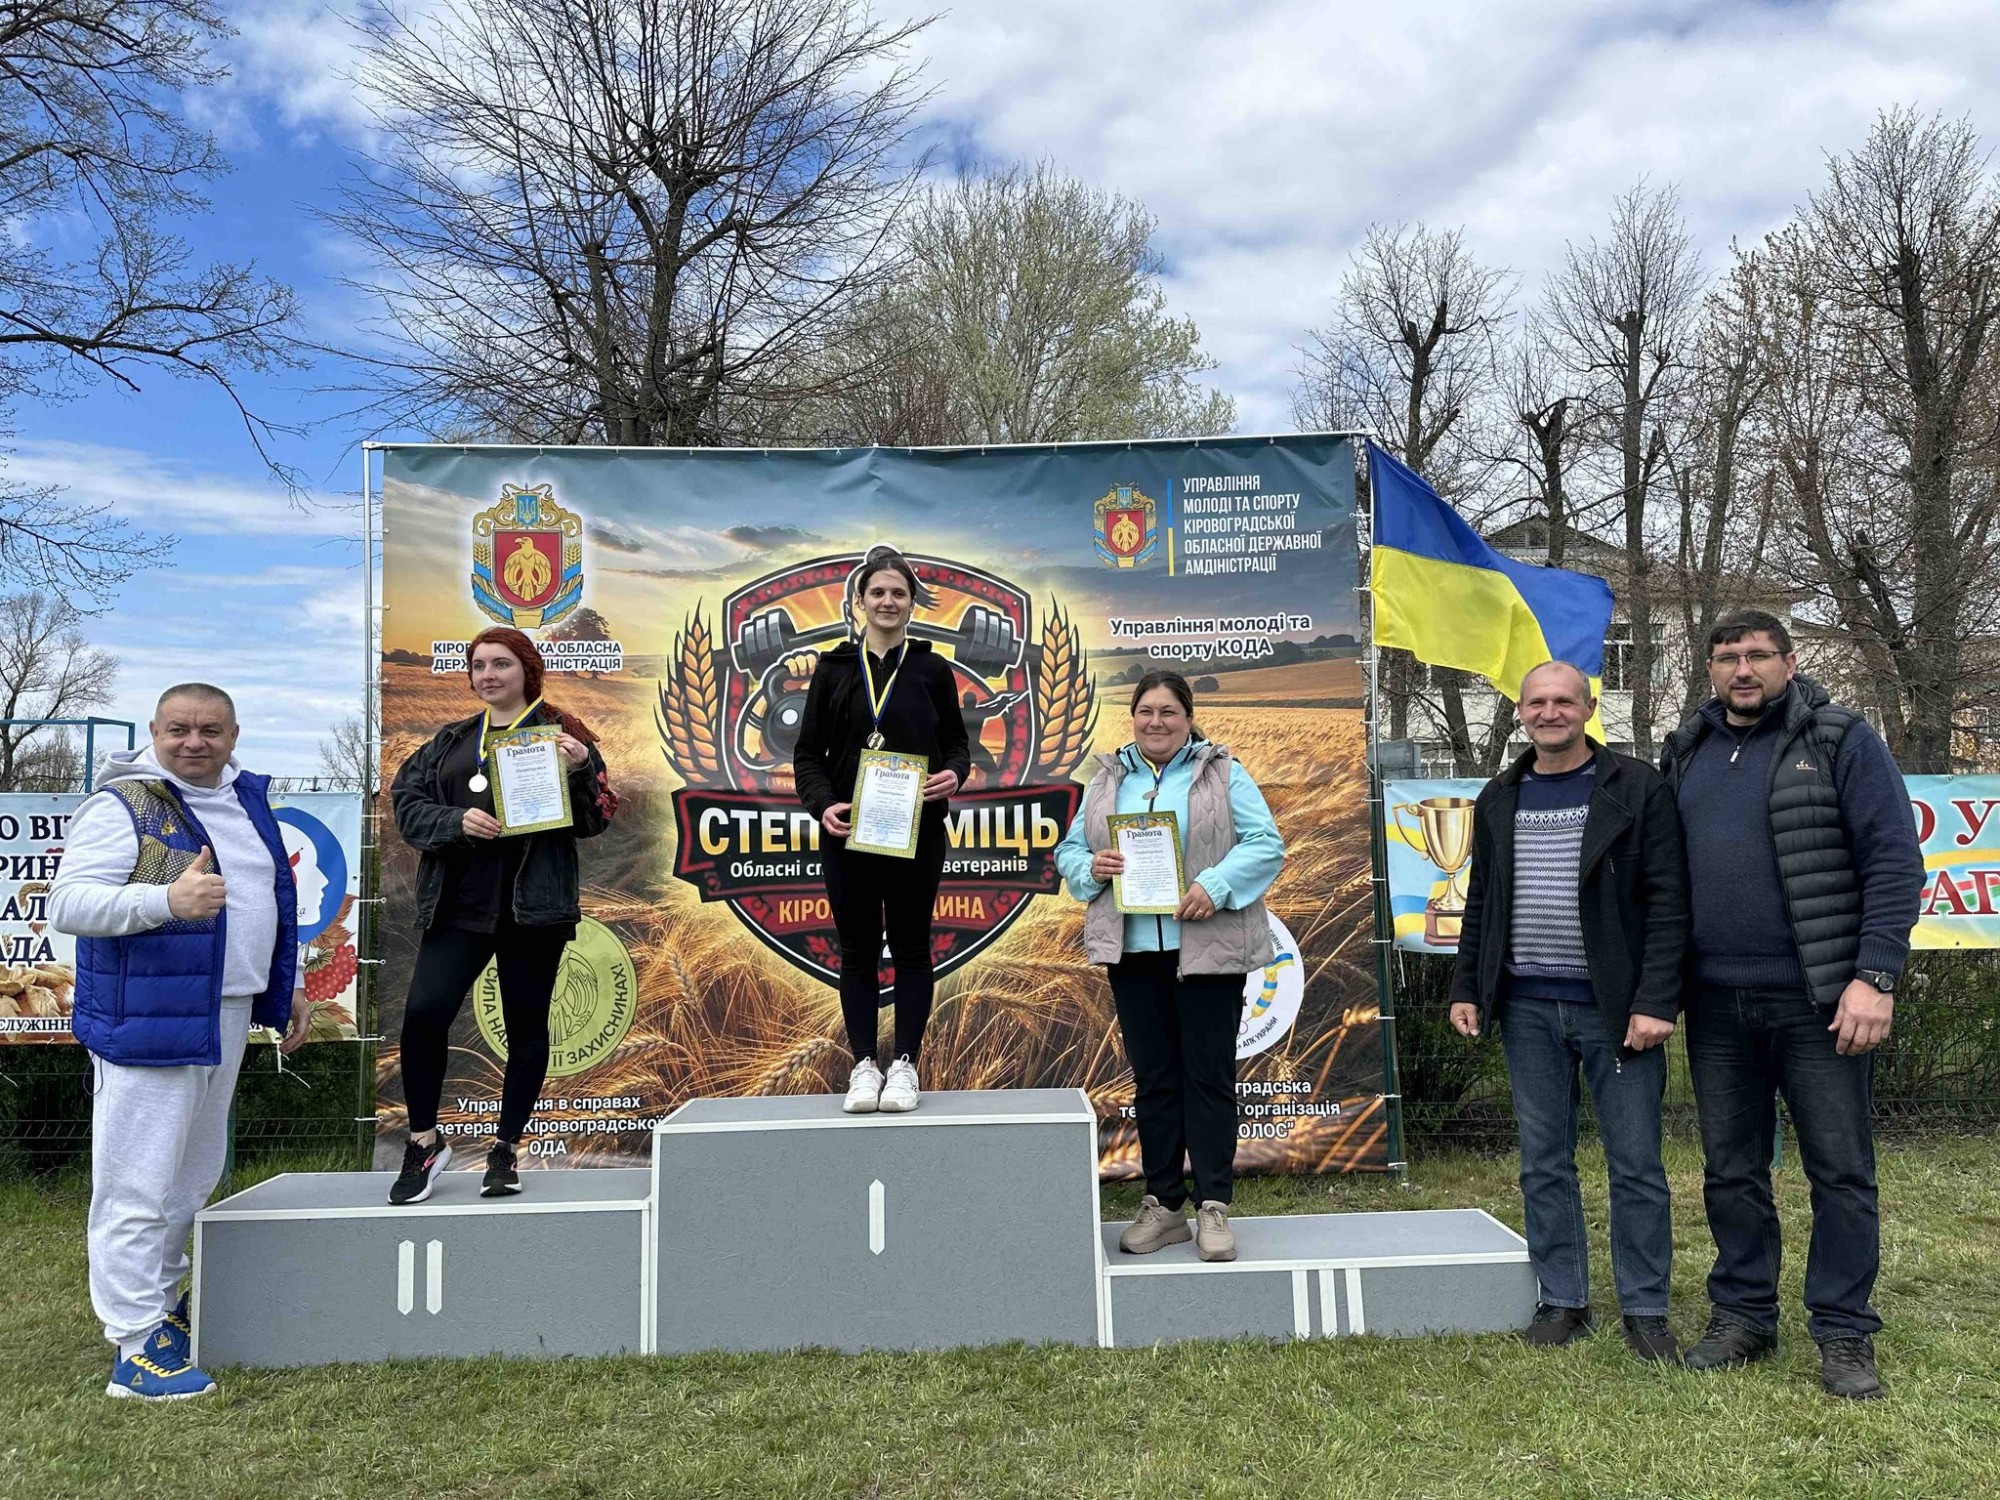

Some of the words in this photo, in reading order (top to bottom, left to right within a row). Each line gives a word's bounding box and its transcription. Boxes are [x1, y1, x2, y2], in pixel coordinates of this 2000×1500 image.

[1183, 475, 1260, 493] УПРАВЛІННЯ
[1183, 497, 1232, 514] МОЛОДІ
[1234, 497, 1251, 511] ТА
[1253, 493, 1300, 510] СПОРТУ
[1184, 511, 1295, 534] КІРОВОГРАДСЬКОЇ
[1184, 534, 1246, 555] ОБЛАСНОЇ
[1248, 530, 1322, 553] ДЕРЖАВНОЇ
[1185, 553, 1277, 575] АМДІНІСТРАЦІЇ
[1111, 616, 1213, 637] Управління
[1219, 614, 1286, 632] молоді
[1289, 616, 1310, 630] та
[557, 642, 622, 654] ОБЛАСНА
[1150, 643, 1215, 659] спорту
[1218, 639, 1273, 657] КОДА
[506, 745, 545, 757] Грамота
[875, 768, 910, 780] Грамота
[699, 807, 820, 856] СТЕП
[1126, 830, 1162, 839] Грамота
[730, 860, 800, 878] Обласні
[942, 855, 1028, 876] ветеранів
[483, 967, 498, 1015] СИЛА
[566, 962, 629, 1065] ЗАХИСНИКАХ!
[1235, 1080, 1311, 1097] градська
[558, 1099, 568, 1110] в
[572, 1096, 641, 1114] справах
[1244, 1101, 1341, 1119] організація
[435, 1122, 500, 1138] ветеран
[529, 1140, 568, 1158] ОДА
